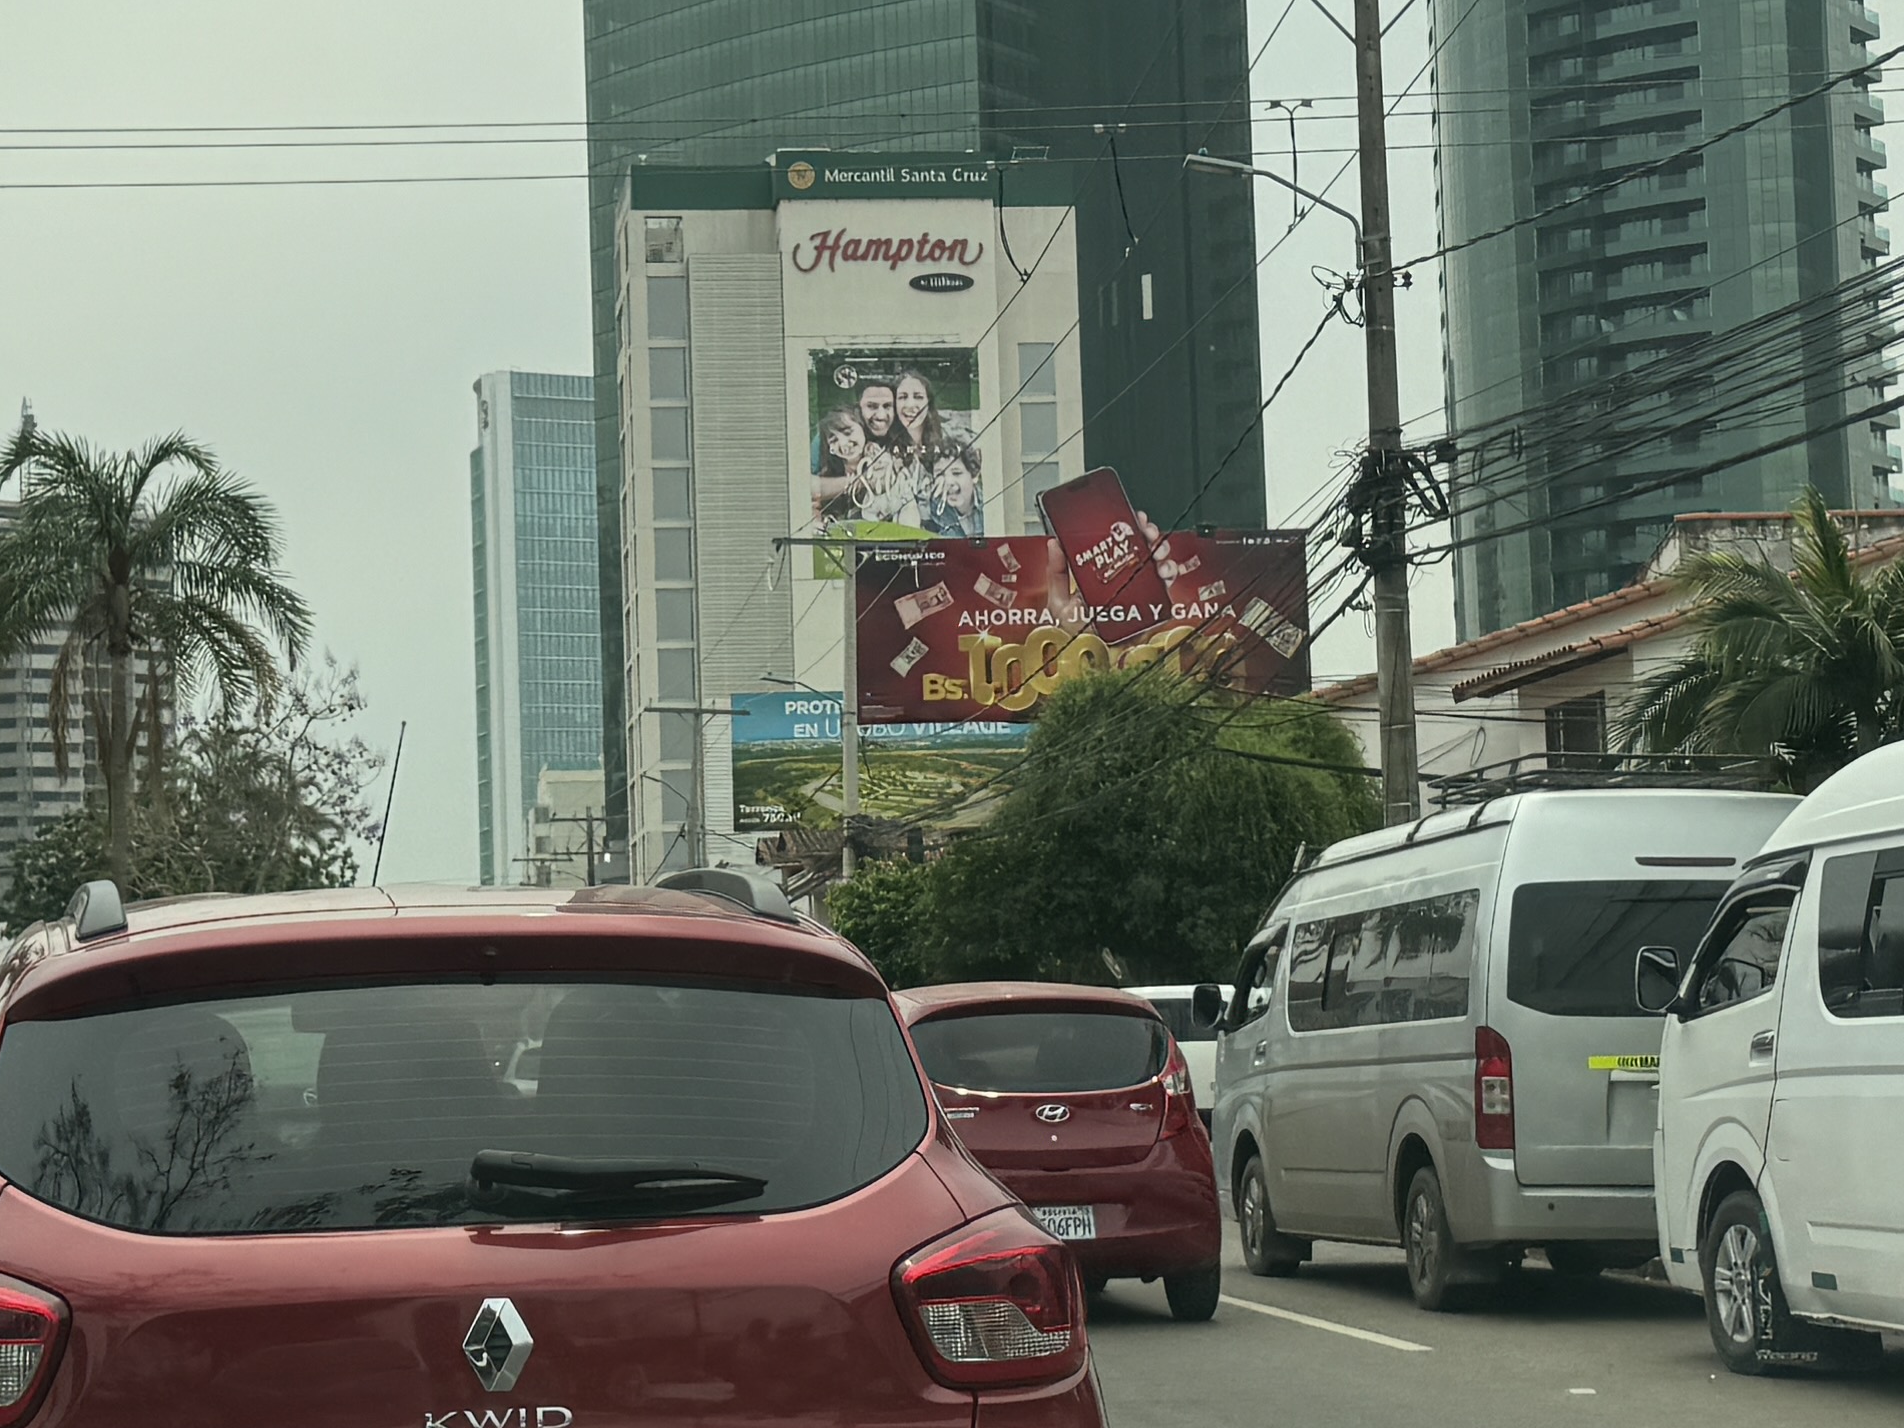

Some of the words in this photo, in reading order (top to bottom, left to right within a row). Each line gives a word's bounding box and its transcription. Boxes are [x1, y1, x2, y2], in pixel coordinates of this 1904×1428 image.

[824, 166, 896, 183] Mercantil
[900, 168, 947, 183] Santa
[952, 168, 989, 183] Cruz
[792, 227, 984, 273] Hampton
[1075, 535, 1113, 567] SMART
[1094, 539, 1130, 570] PLAY
[958, 607, 1061, 627] AHORRA,
[1069, 605, 1143, 623] JUEGA
[1149, 603, 1164, 621] Y
[1170, 601, 1237, 620] GANA
[793, 722, 819, 738] EN
